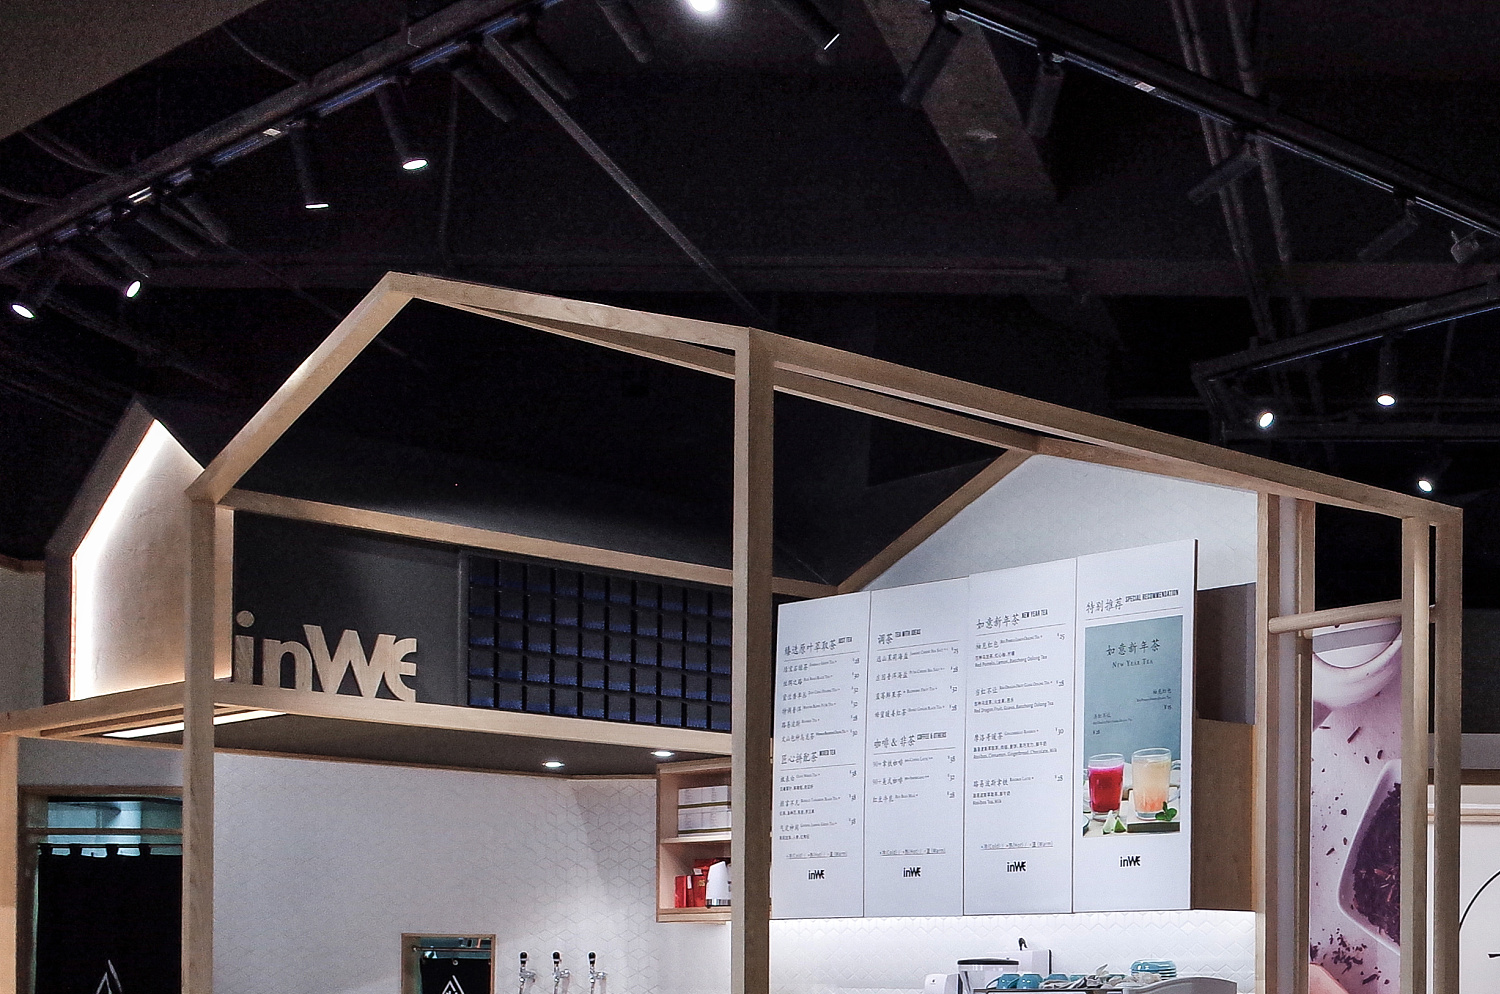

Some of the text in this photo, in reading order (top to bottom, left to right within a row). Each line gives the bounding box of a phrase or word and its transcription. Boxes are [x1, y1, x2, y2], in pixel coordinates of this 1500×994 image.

[1085, 597, 1123, 614] 特别推荐
[1125, 594, 1141, 603] SPECIAL
[976, 613, 1020, 630] 如意新年茶
[236, 610, 417, 703] inWE
[1105, 638, 1161, 657] 如意新年茶
